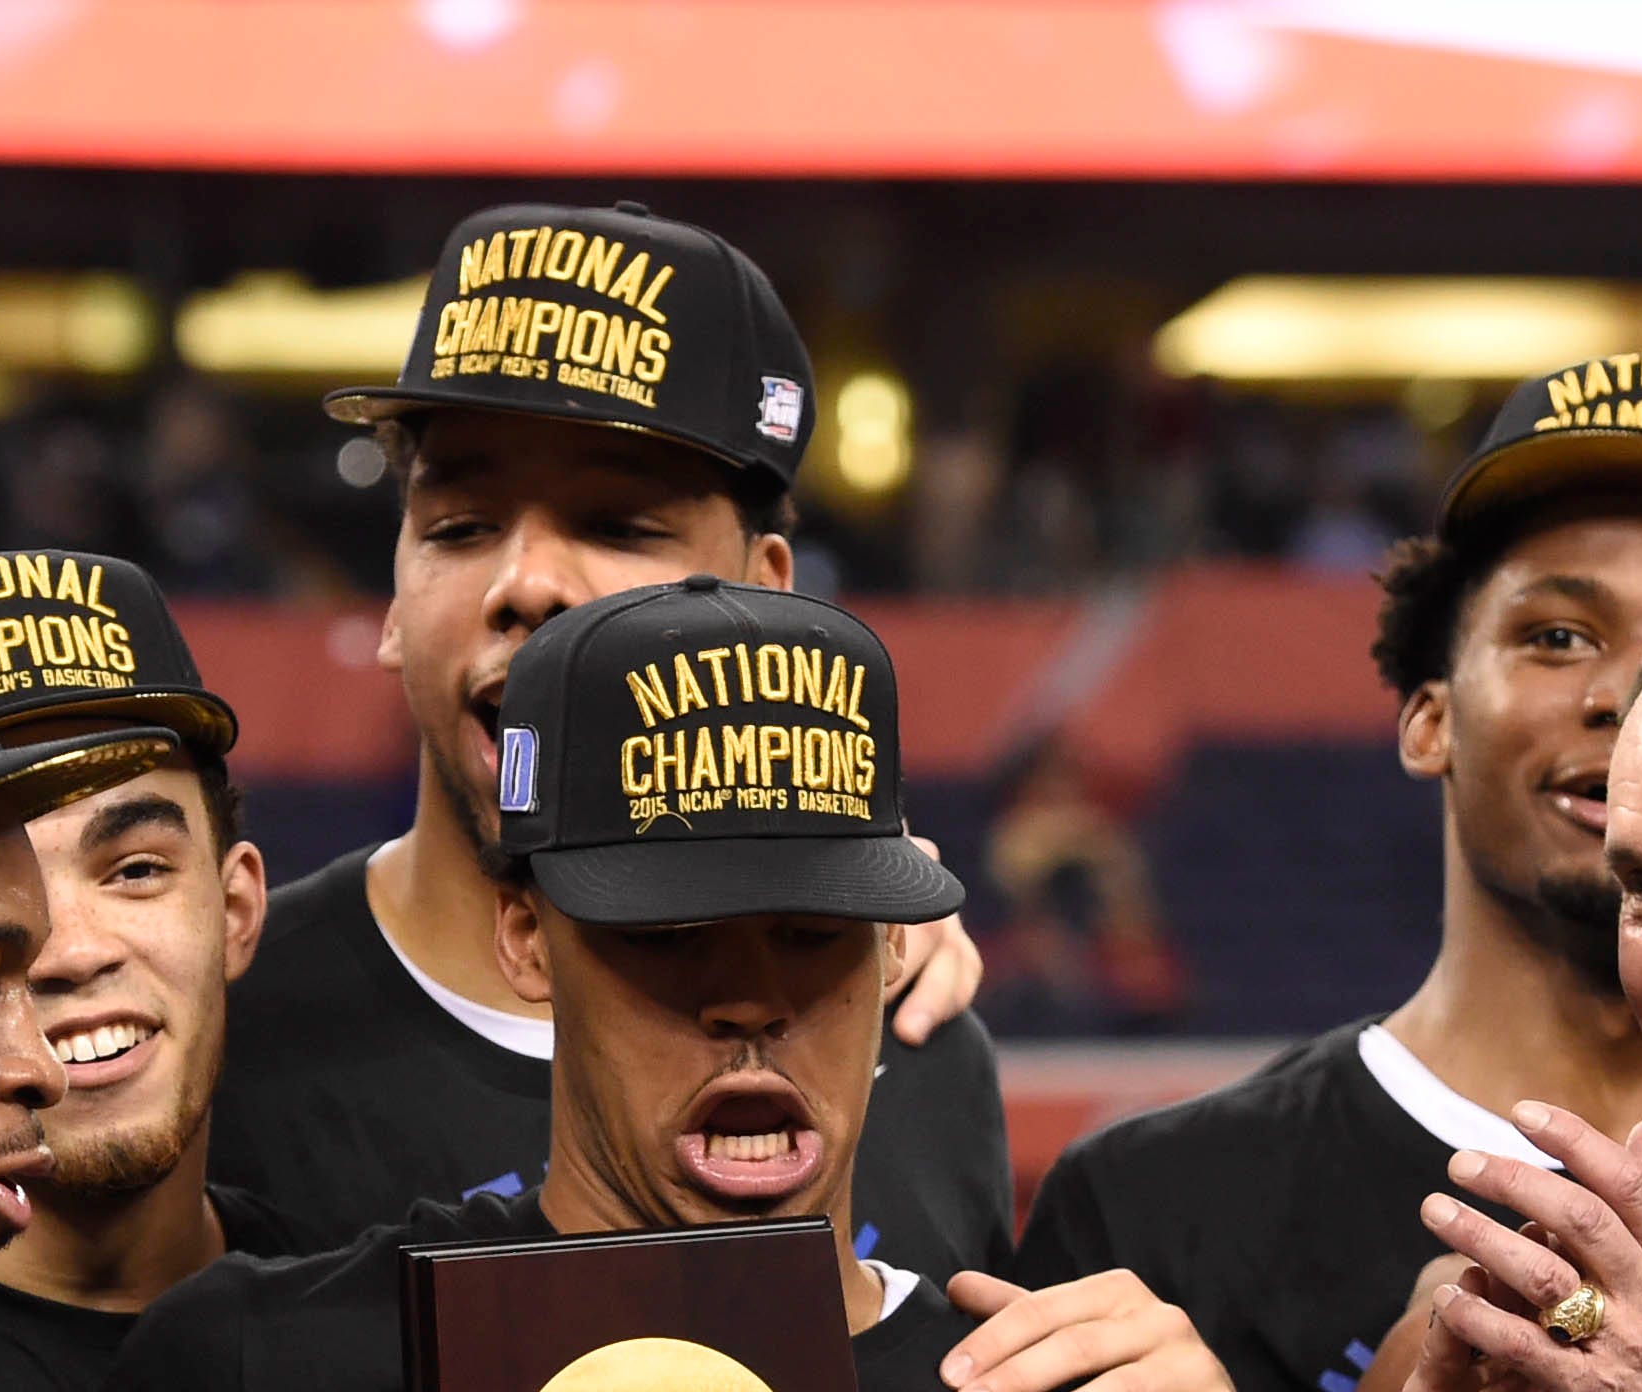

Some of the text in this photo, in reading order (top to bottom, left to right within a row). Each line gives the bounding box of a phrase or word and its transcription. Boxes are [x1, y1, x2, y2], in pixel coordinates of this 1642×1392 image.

[459, 226, 675, 326] NATIONAL
[434, 296, 671, 384] CHAMPIONS
[556, 360, 658, 410] BASKETBALL
[626, 643, 870, 732] NATIONAL
[621, 724, 876, 798] CHAMPIONS
[629, 797, 669, 820] 2015
[737, 785, 789, 812] MEN'S
[797, 788, 872, 821] BASKETBALL
